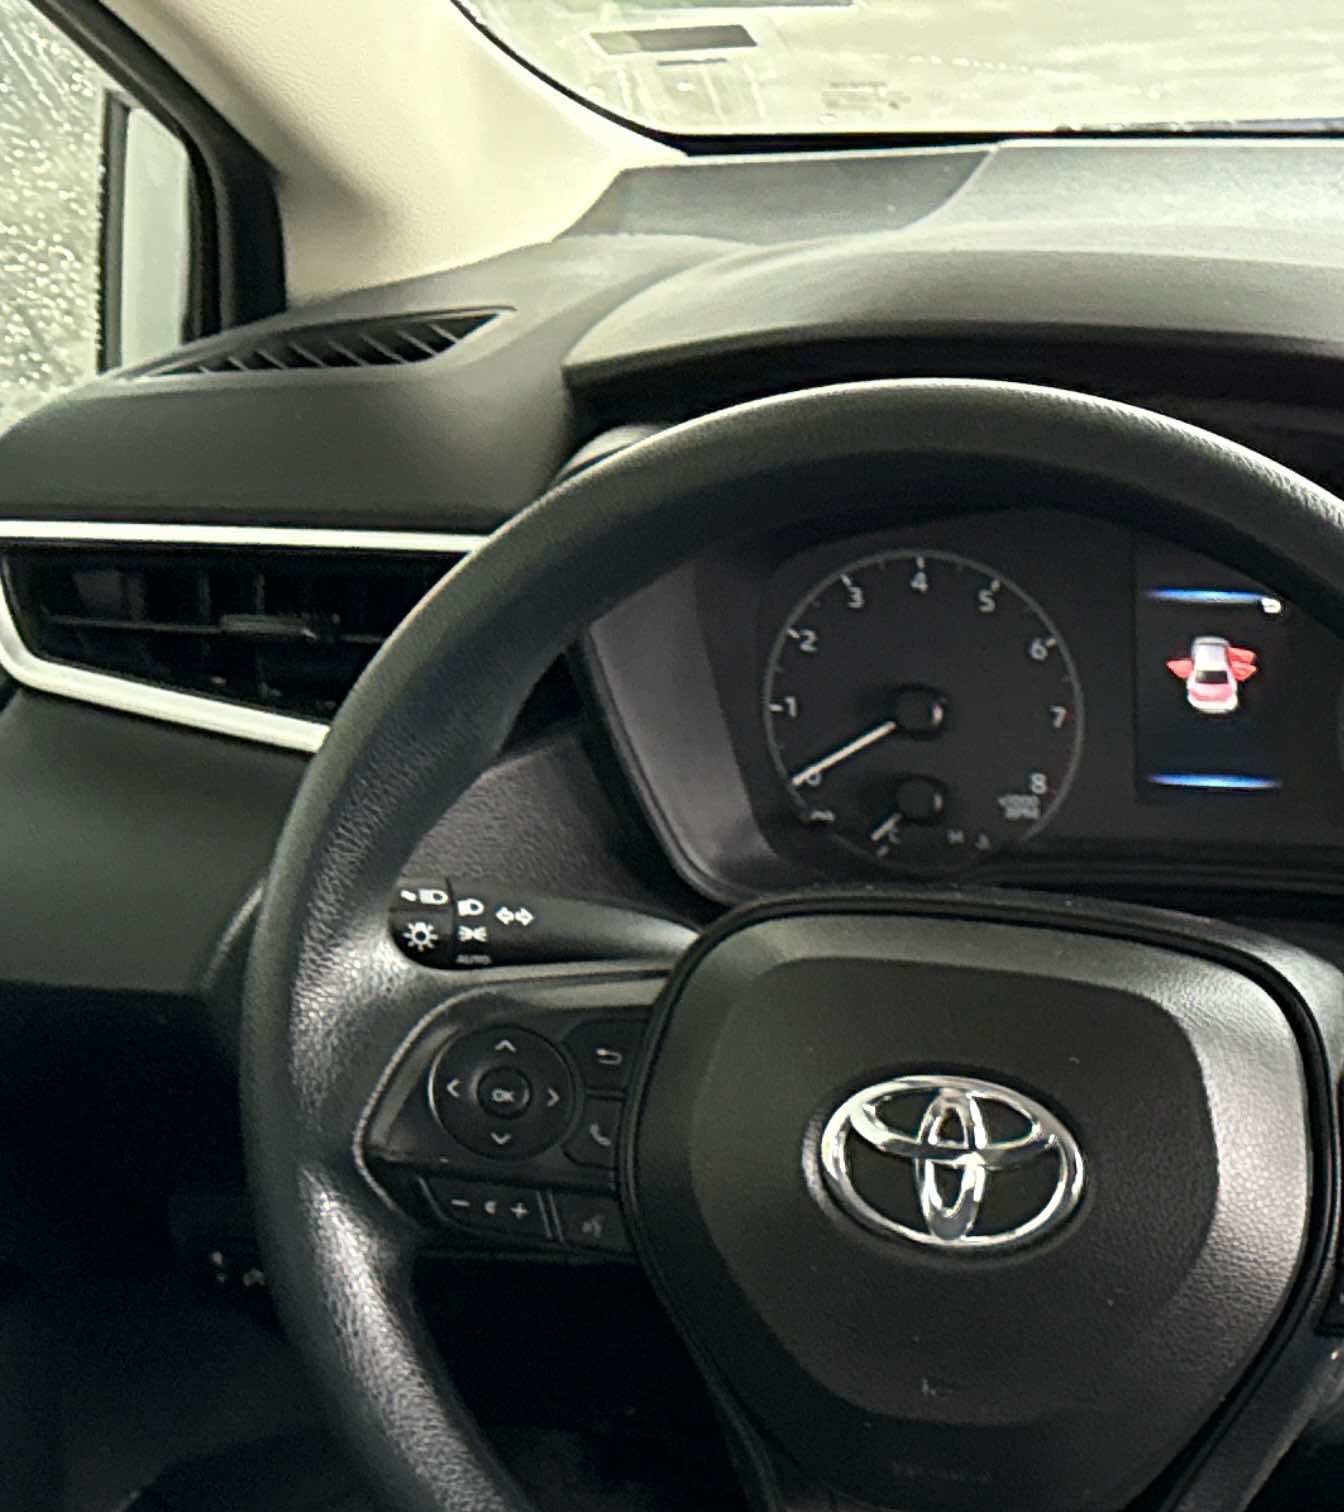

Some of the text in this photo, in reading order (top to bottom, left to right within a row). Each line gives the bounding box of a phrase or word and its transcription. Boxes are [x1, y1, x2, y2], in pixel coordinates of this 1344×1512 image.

[911, 572, 928, 593] 4
[848, 587, 864, 608] 3
[978, 590, 996, 613] 5
[800, 631, 818, 653] 2
[1029, 639, 1049, 661] 6
[784, 696, 797, 718] 1
[1050, 706, 1067, 728] 7
[1030, 772, 1048, 795] 8
